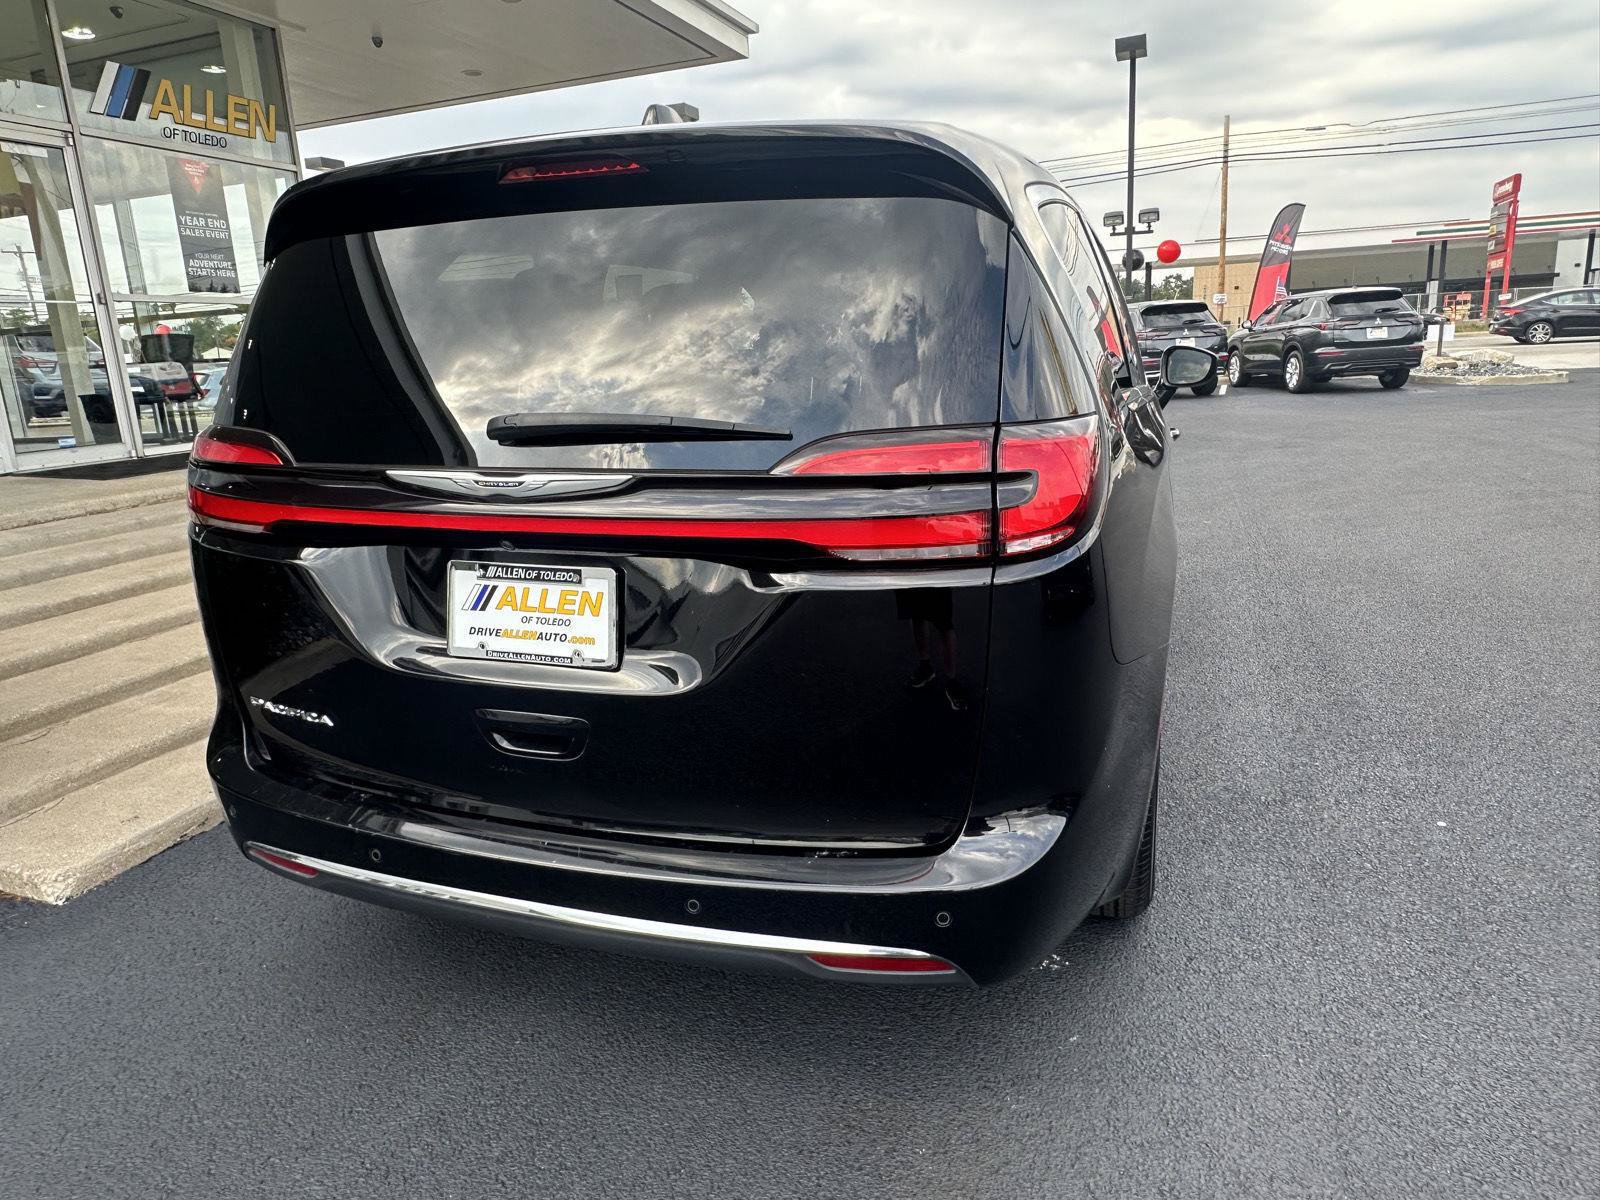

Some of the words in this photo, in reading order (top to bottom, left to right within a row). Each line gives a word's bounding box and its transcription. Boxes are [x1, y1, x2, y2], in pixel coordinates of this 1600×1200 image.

[149, 79, 276, 143] ALLEN
[163, 126, 180, 140] OF
[182, 131, 228, 149] TOLEDO
[179, 215, 206, 226] YEAR
[208, 219, 227, 229] END
[180, 228, 205, 237] SALES
[206, 230, 229, 239] EVENT
[189, 259, 233, 269] ADVENTURE
[188, 268, 216, 277] STARTS
[217, 270, 236, 278] HERE
[496, 566, 526, 579] ALLEN
[526, 569, 539, 579] OF
[540, 571, 574, 582] TOLEDO
[495, 586, 604, 617] ALLEN
[521, 616, 535, 625] OF
[536, 617, 571, 627] TOLEDO
